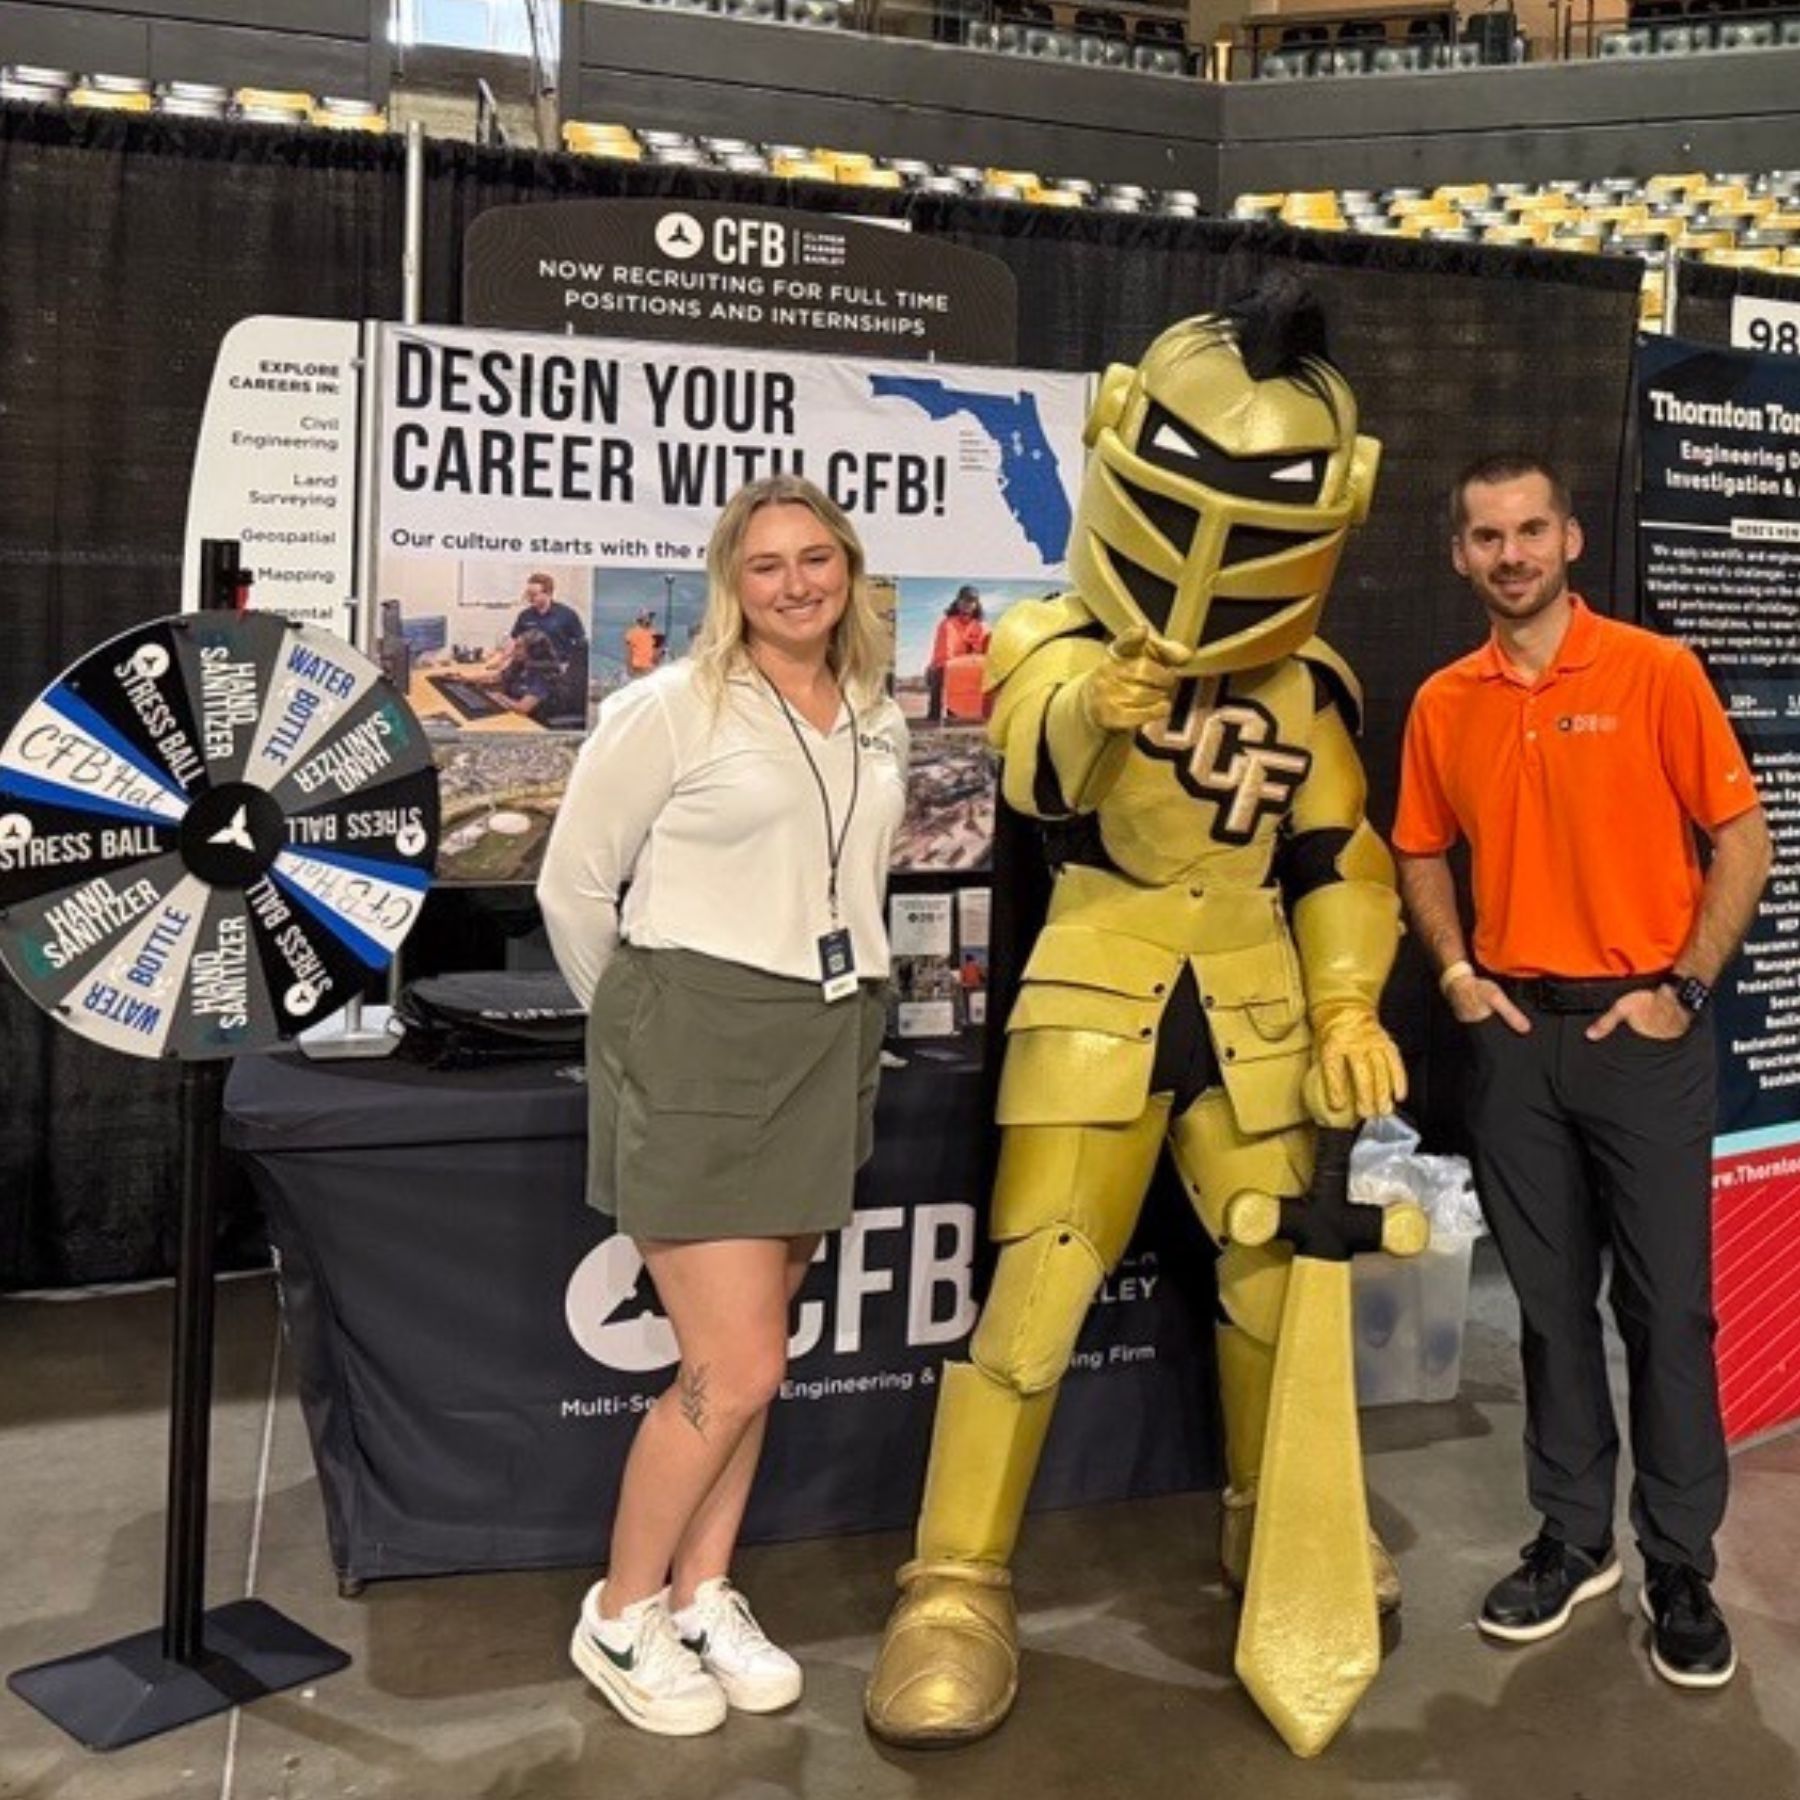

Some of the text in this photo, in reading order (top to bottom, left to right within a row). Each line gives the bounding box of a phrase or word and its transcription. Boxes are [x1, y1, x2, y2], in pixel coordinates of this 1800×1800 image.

[713, 217, 785, 268] CFB
[539, 259, 949, 313] NOW RECRUITING FOR FULL TIME
[564, 289, 926, 337] POSITIONS AND INTERNSHIPS
[229, 375, 340, 395] CAREERS IN:
[259, 359, 340, 378] EXPLORE
[396, 340, 796, 435] DESIGN YOUR
[300, 416, 339, 431] Civil
[1649, 390, 1764, 431] Thornton
[232, 431, 339, 450] Engineering
[1680, 439, 1786, 473] Engineering
[293, 474, 338, 488] Land
[393, 422, 635, 503] CAREER
[827, 447, 946, 517] CFB!
[1666, 467, 1780, 498] Investigation
[248, 491, 336, 509] Surveying
[241, 529, 336, 545] Geospatial
[391, 528, 435, 547] Our
[441, 531, 523, 552] culture
[530, 535, 593, 556] starts
[601, 538, 648, 558] with
[655, 541, 691, 559] the
[257, 568, 335, 585] Mapping
[227, 662, 257, 726] HAND
[287, 643, 356, 700] WATER
[113, 655, 205, 790] STRESS BALL
[201, 646, 234, 760] SANITIZER
[262, 688, 321, 766] BOTTLE
[18, 723, 166, 805] CFB Hat
[292, 711, 392, 793] SANITIZER
[333, 741, 392, 794] HAND
[0, 825, 163, 871] STRESS BALL
[285, 806, 423, 845] STRESS BALL
[43, 878, 161, 969] SANITIZER
[44, 877, 117, 935] HAND
[126, 906, 191, 988] BOTTLE
[245, 873, 334, 997] STRESS BALL
[191, 950, 222, 1016] HAND
[217, 915, 247, 1030] SANITIZER
[83, 980, 161, 1036] WATER
[1101, 1275, 1159, 1303] LEY
[1108, 1345, 1156, 1362] Firm
[561, 1367, 935, 1418] Multi-Se Engineering &
